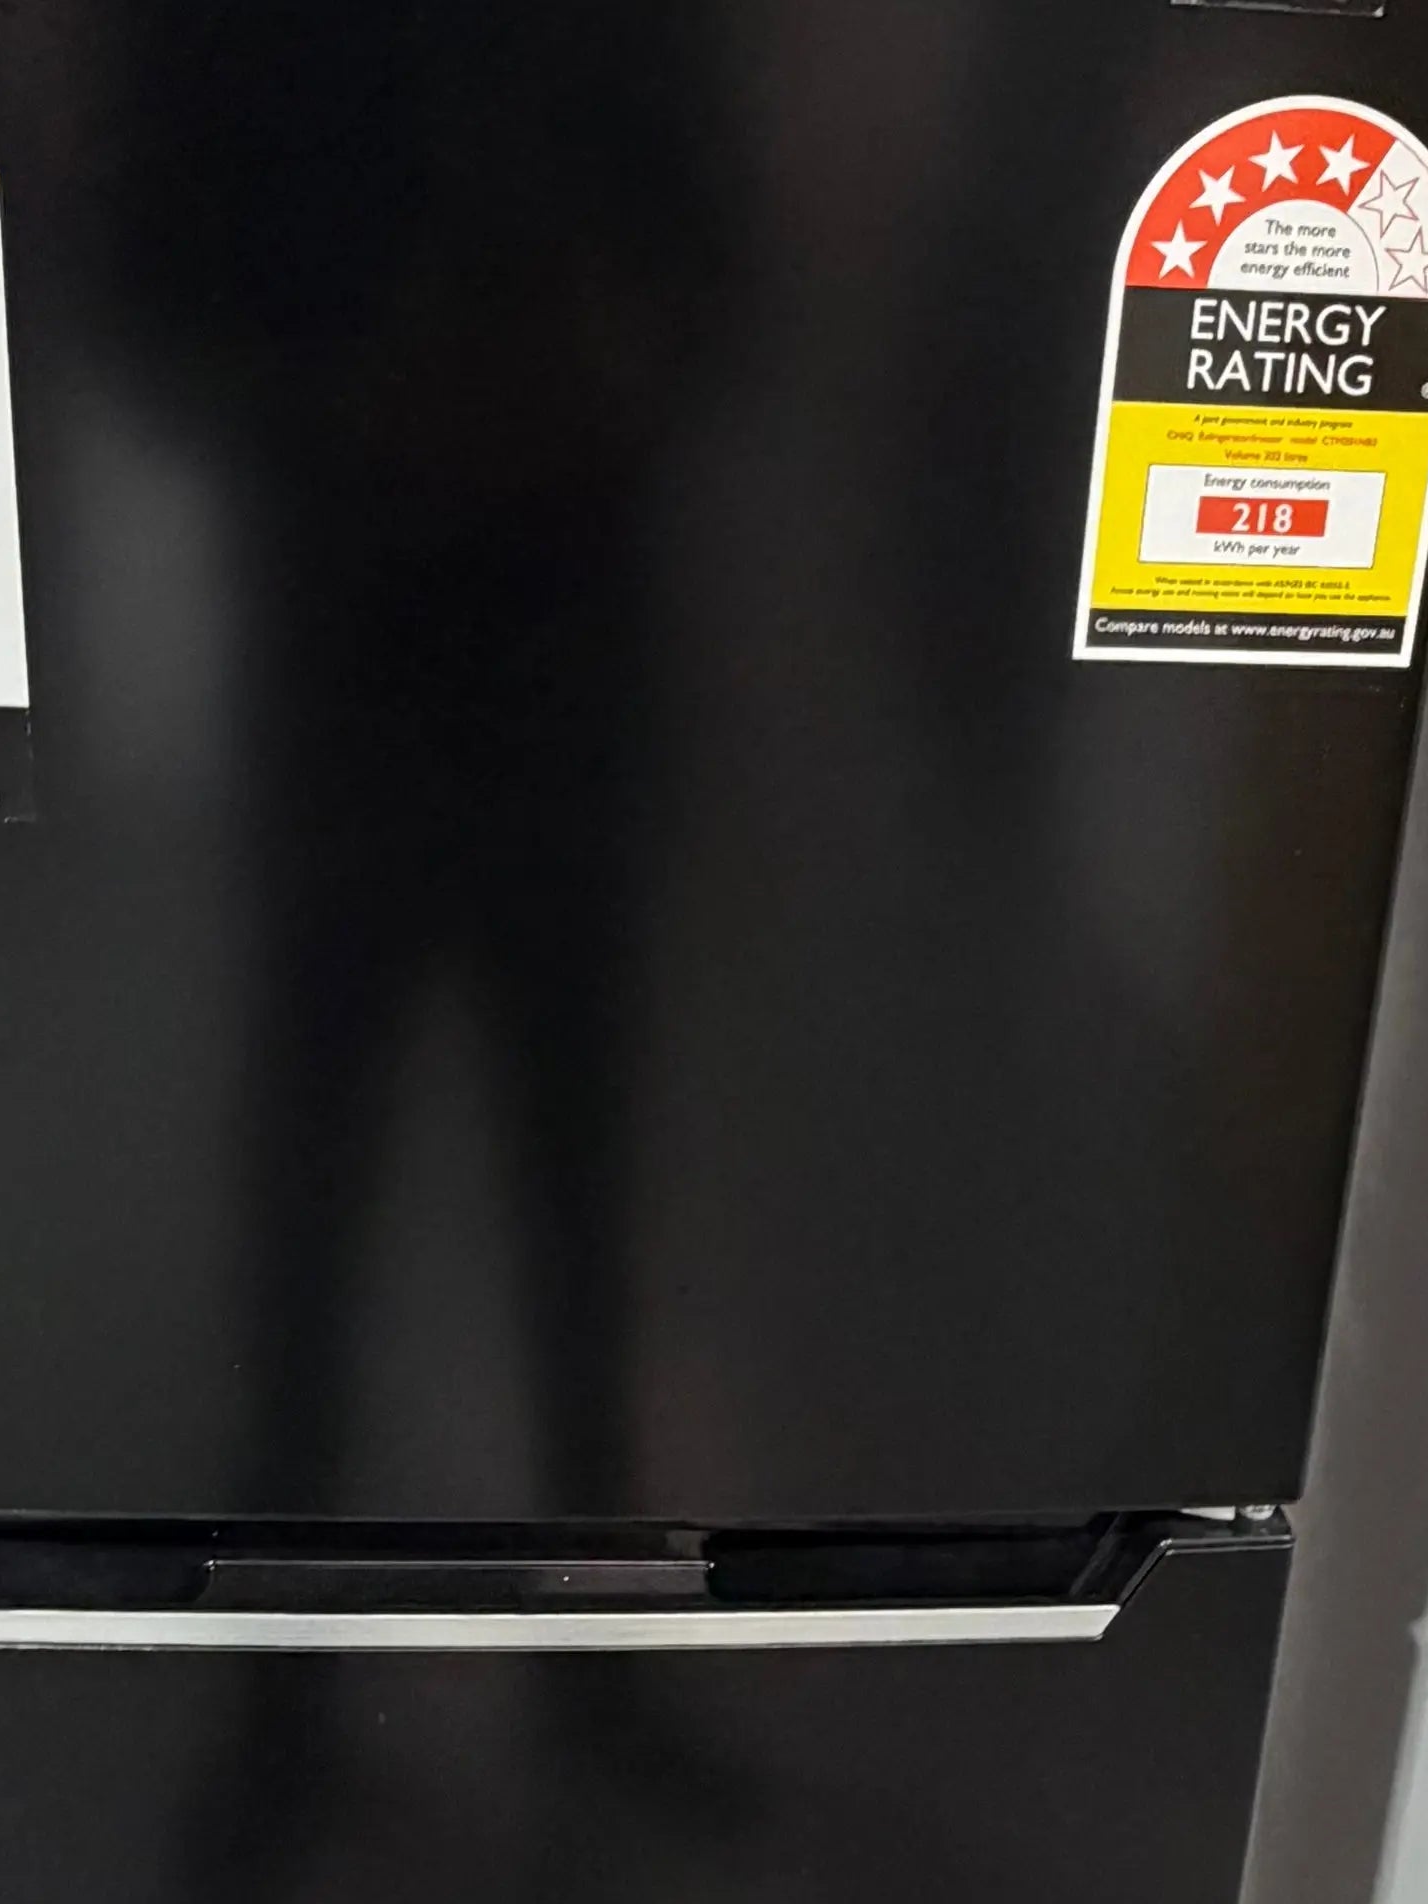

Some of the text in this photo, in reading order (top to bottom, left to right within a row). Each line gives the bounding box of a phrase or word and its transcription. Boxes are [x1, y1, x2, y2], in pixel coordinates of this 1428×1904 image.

[1265, 219, 1337, 239] The more
[1244, 241, 1351, 258] stars the more
[1240, 261, 1350, 280] energy efficient
[1190, 297, 1388, 346] ENERGY
[1187, 348, 1374, 397] RATING
[1204, 473, 1331, 493] Energy consumption
[1231, 502, 1293, 533] 218
[1213, 539, 1301, 559] kWh per year
[1094, 617, 1396, 643] Compare models at www.energyrating.gov.au
